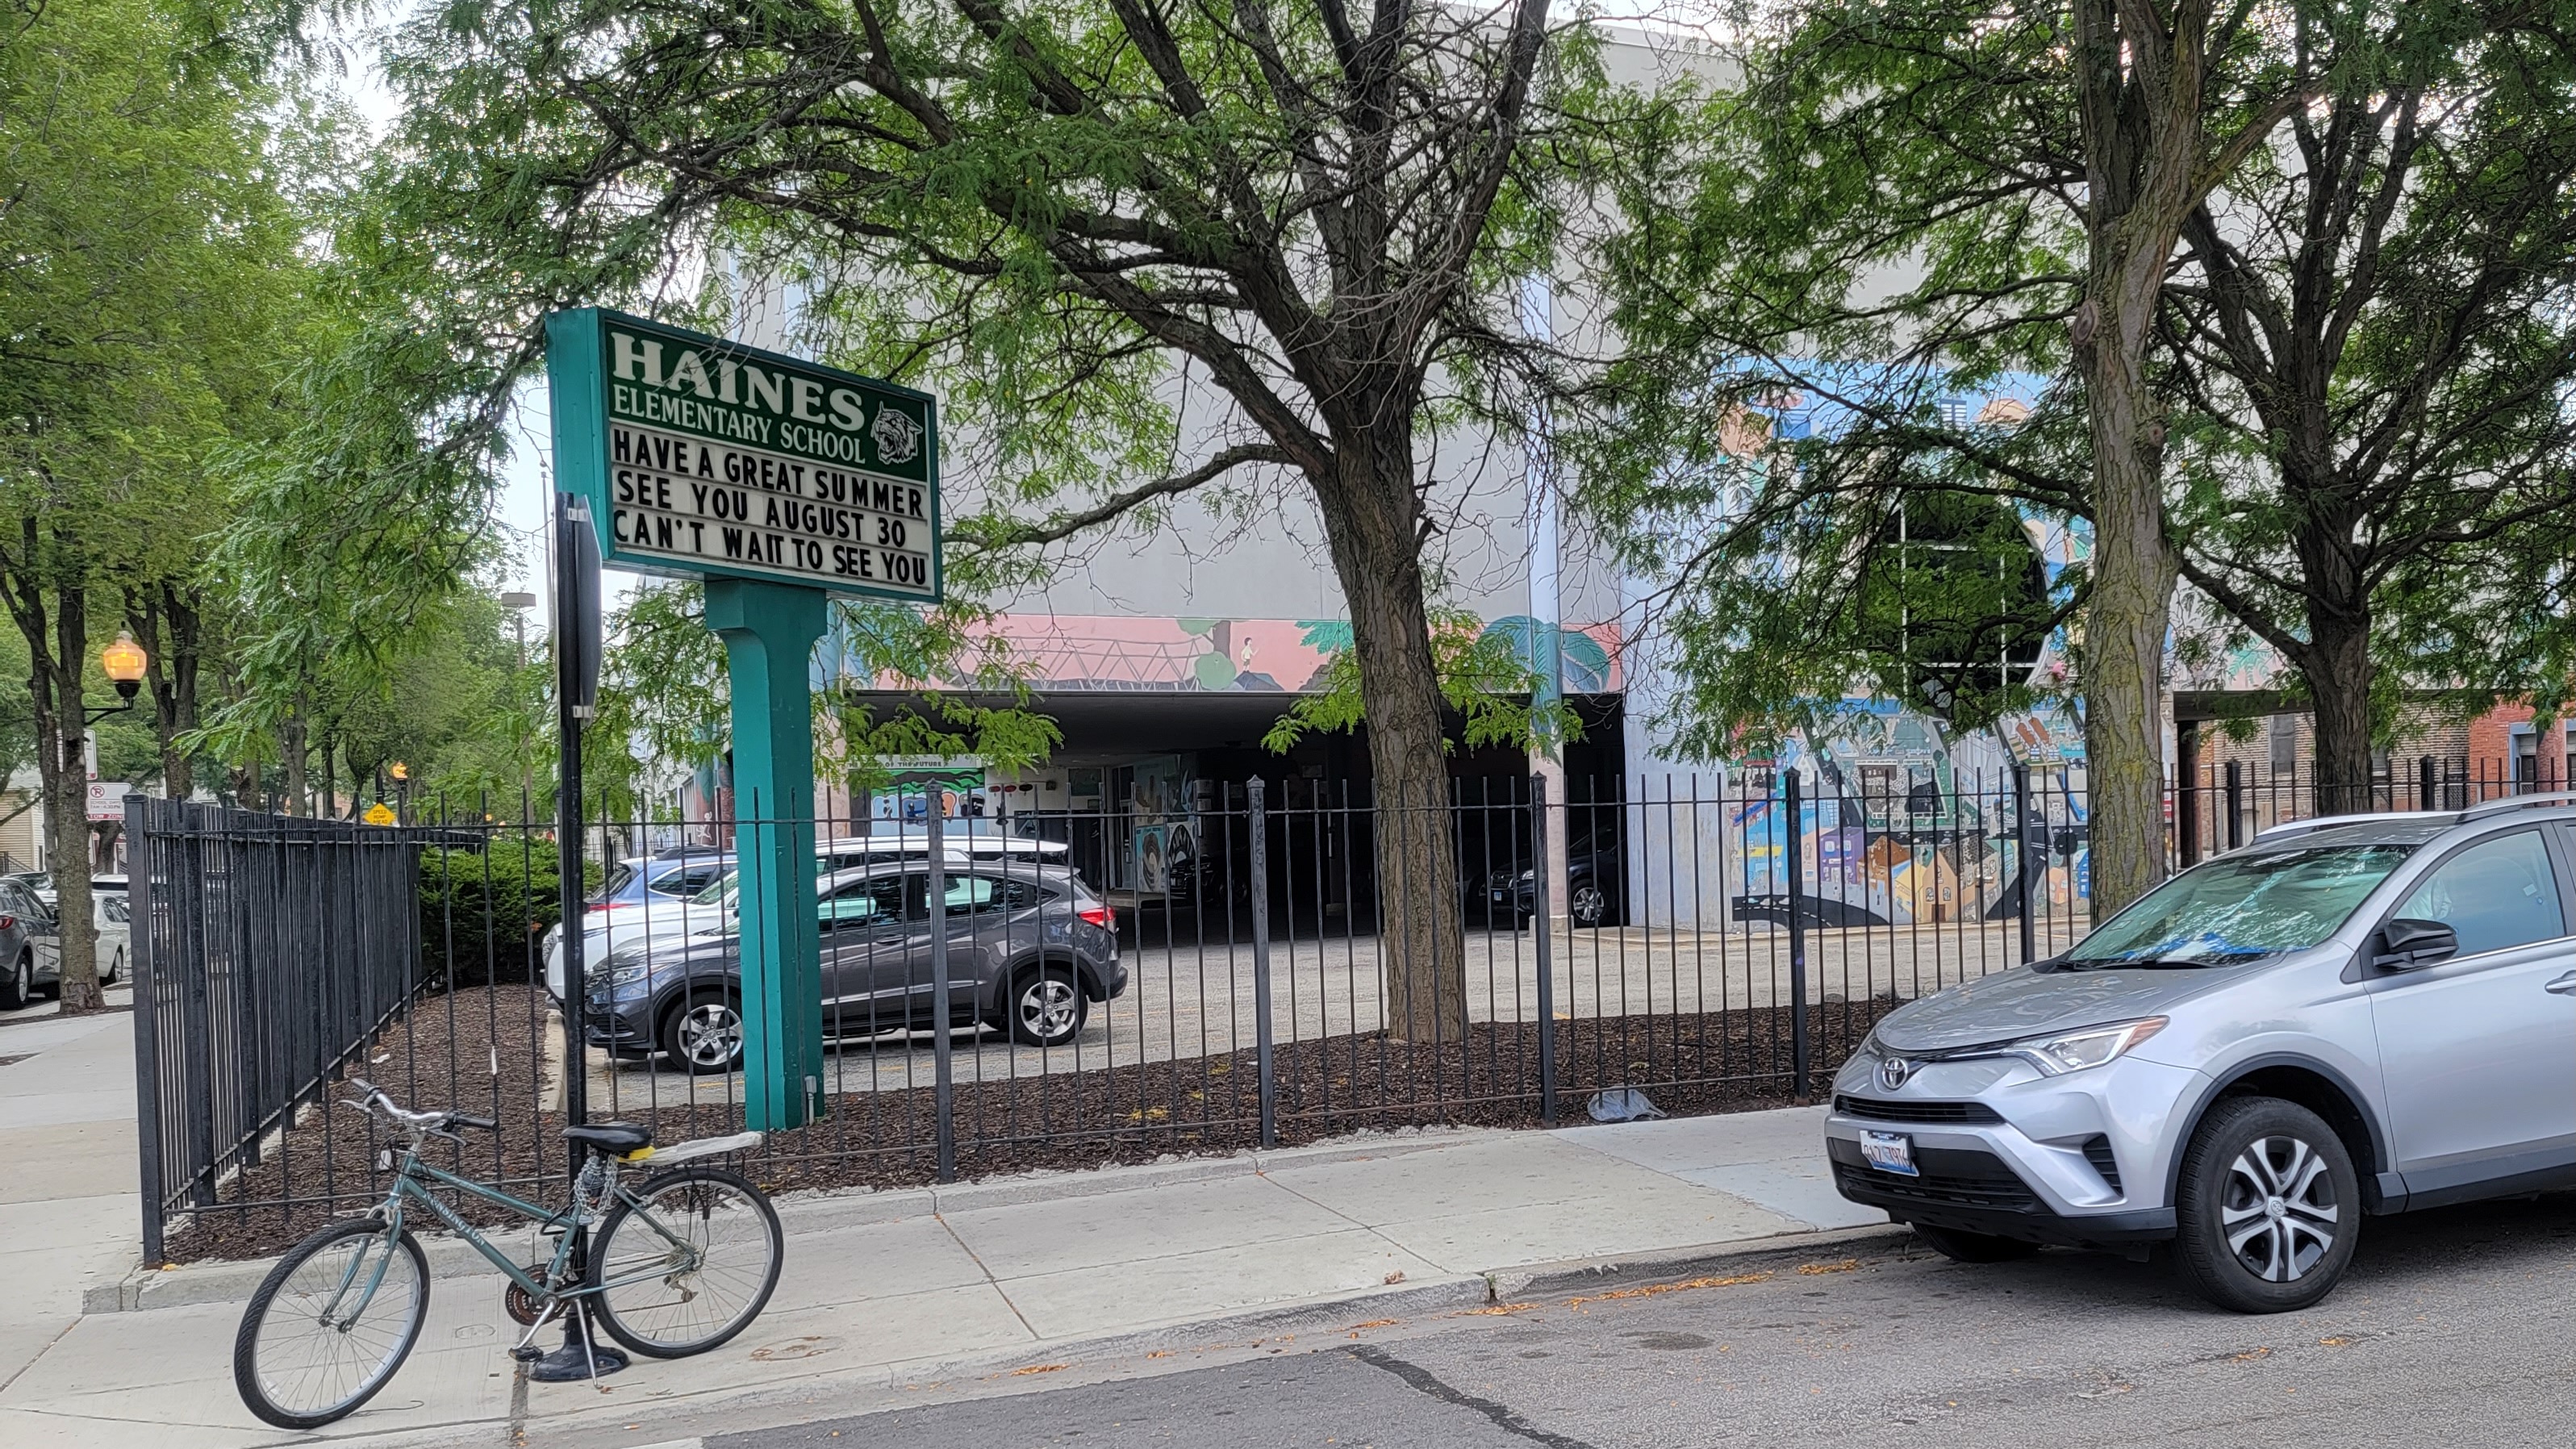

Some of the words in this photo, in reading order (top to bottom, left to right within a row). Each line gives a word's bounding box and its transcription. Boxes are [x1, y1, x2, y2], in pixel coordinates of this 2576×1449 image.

[611, 332, 865, 432] HAINES
[613, 384, 771, 444] ELEMENTARY
[780, 422, 866, 464] SCHOOL
[614, 429, 690, 474] HAVE
[699, 447, 714, 478] A
[725, 453, 804, 495] GREAT
[816, 470, 923, 517] SUMMER
[617, 470, 672, 509] SEE
[691, 483, 748, 520] YOU
[766, 497, 863, 541] AUGUST
[878, 517, 906, 548] 30
[614, 509, 704, 553] CAN'T
[722, 527, 785, 561] WAIT
[791, 538, 822, 570] TO
[833, 545, 872, 577] SEE
[881, 552, 926, 585] YOU
